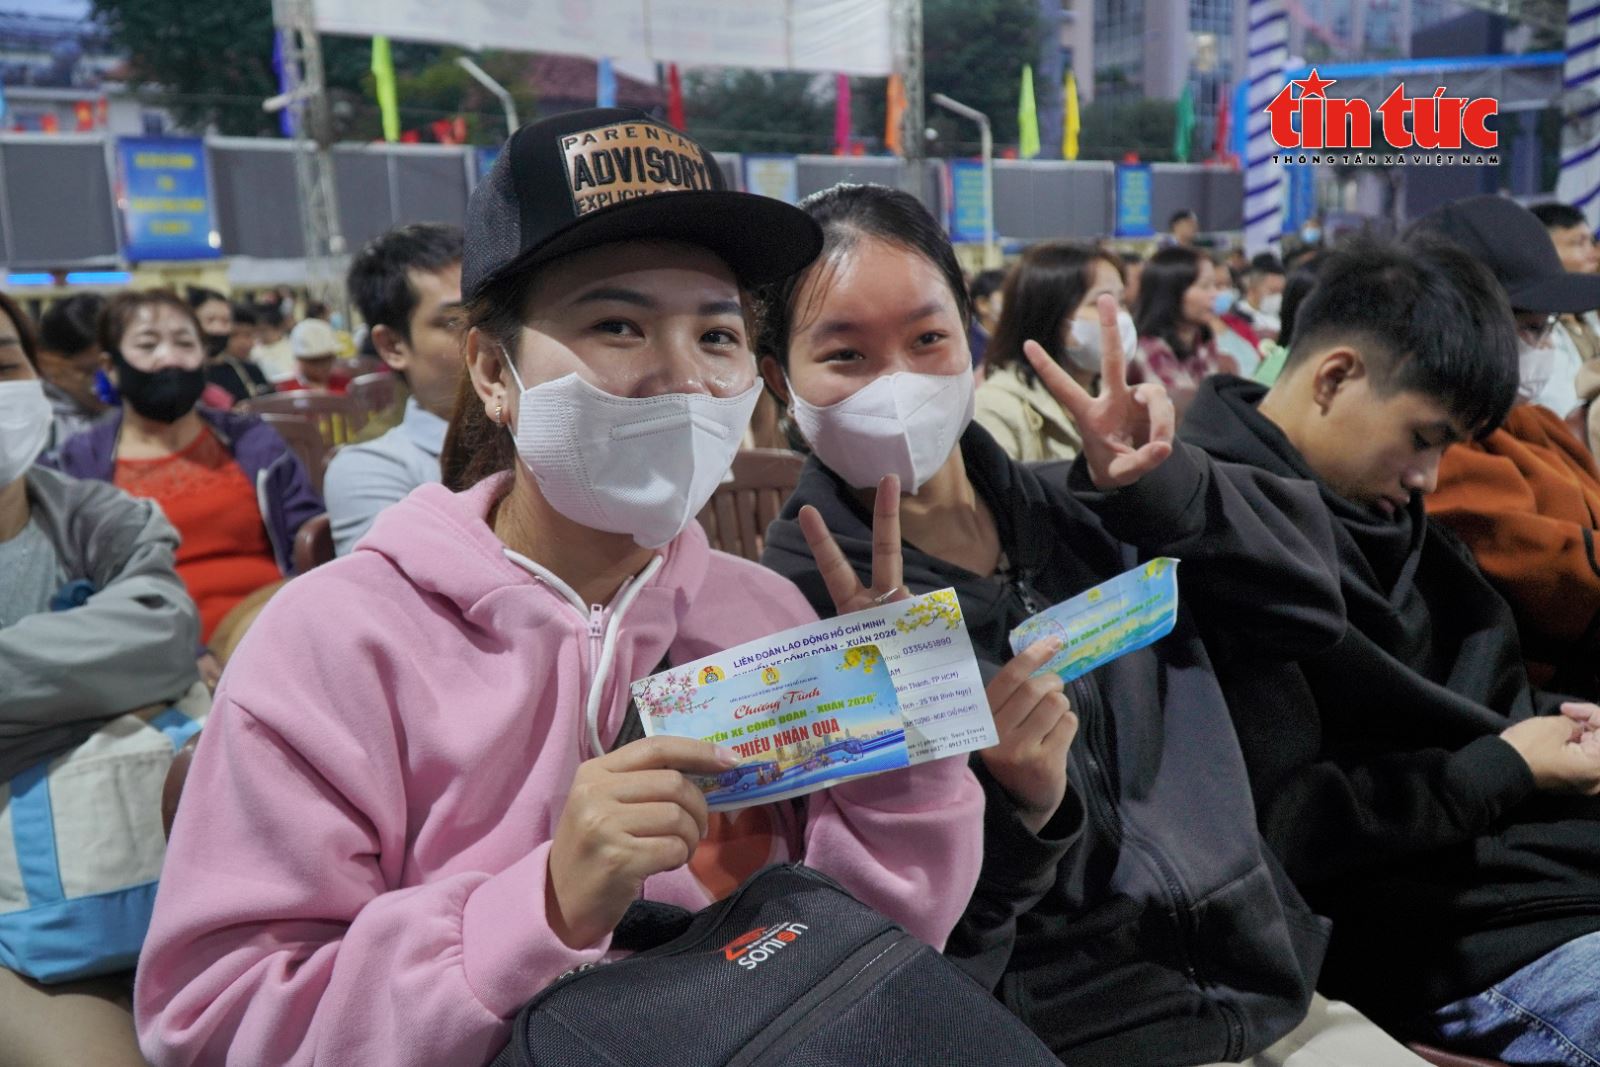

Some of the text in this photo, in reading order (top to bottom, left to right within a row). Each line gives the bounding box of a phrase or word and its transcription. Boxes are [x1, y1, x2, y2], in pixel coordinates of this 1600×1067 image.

[565, 126, 700, 155] PARENTAL
[574, 146, 708, 191] ADVISORY
[733, 653, 755, 669] LIÊN
[782, 640, 801, 652] LAO
[802, 633, 830, 650] ĐỘNG
[845, 621, 861, 636] CHÍ
[862, 618, 886, 632] MINH
[846, 633, 872, 648] XUÂN
[873, 628, 897, 641] 2026
[731, 727, 744, 738] XE
